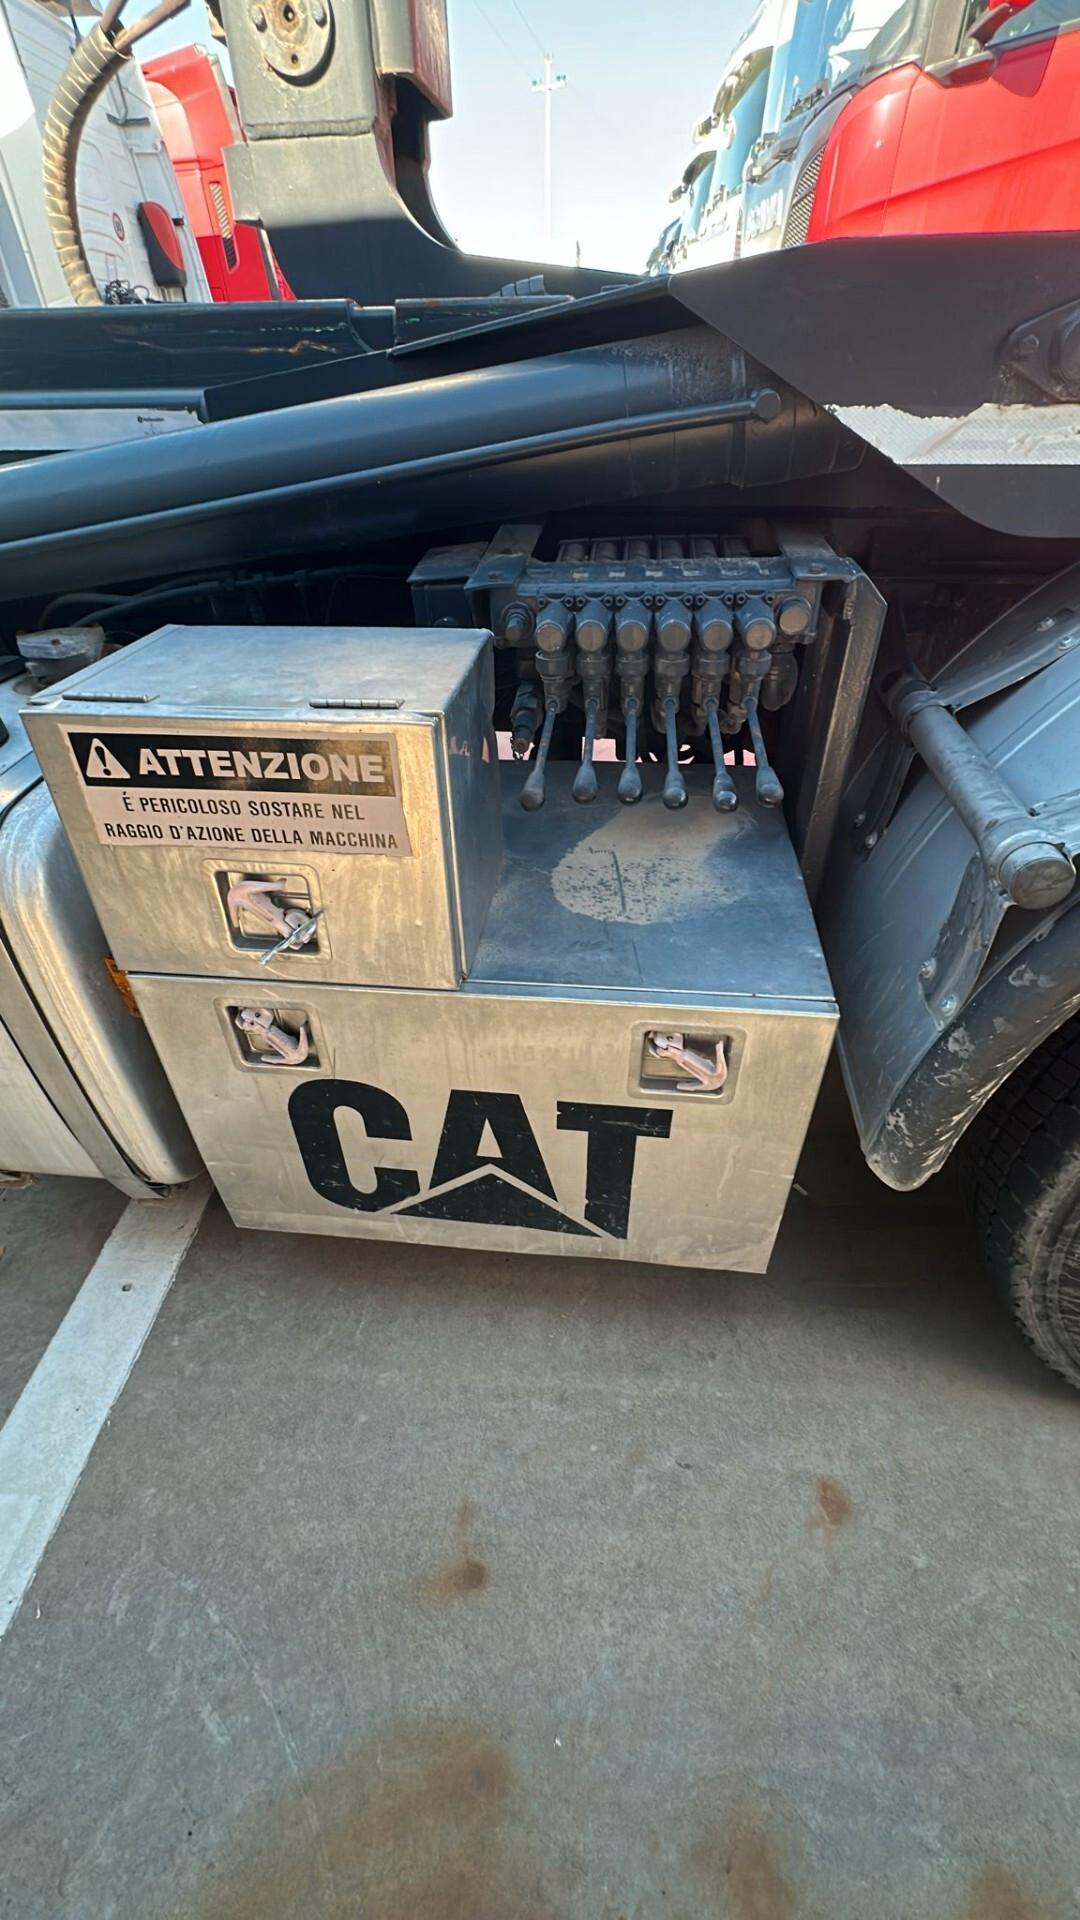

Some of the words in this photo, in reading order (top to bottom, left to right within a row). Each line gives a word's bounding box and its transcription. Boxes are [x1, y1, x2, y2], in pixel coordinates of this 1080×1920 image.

[138, 748, 386, 783] ATTENZIONE
[140, 796, 242, 816] PERICOLOSO
[249, 801, 325, 820] SOSTARE
[331, 804, 365, 821] NEL
[104, 823, 164, 839] RAGGIO
[171, 825, 246, 842] D'AZIONE
[252, 828, 302, 845] DELLA
[309, 831, 398, 849] MACCHINA
[288, 1078, 674, 1240] CAT
